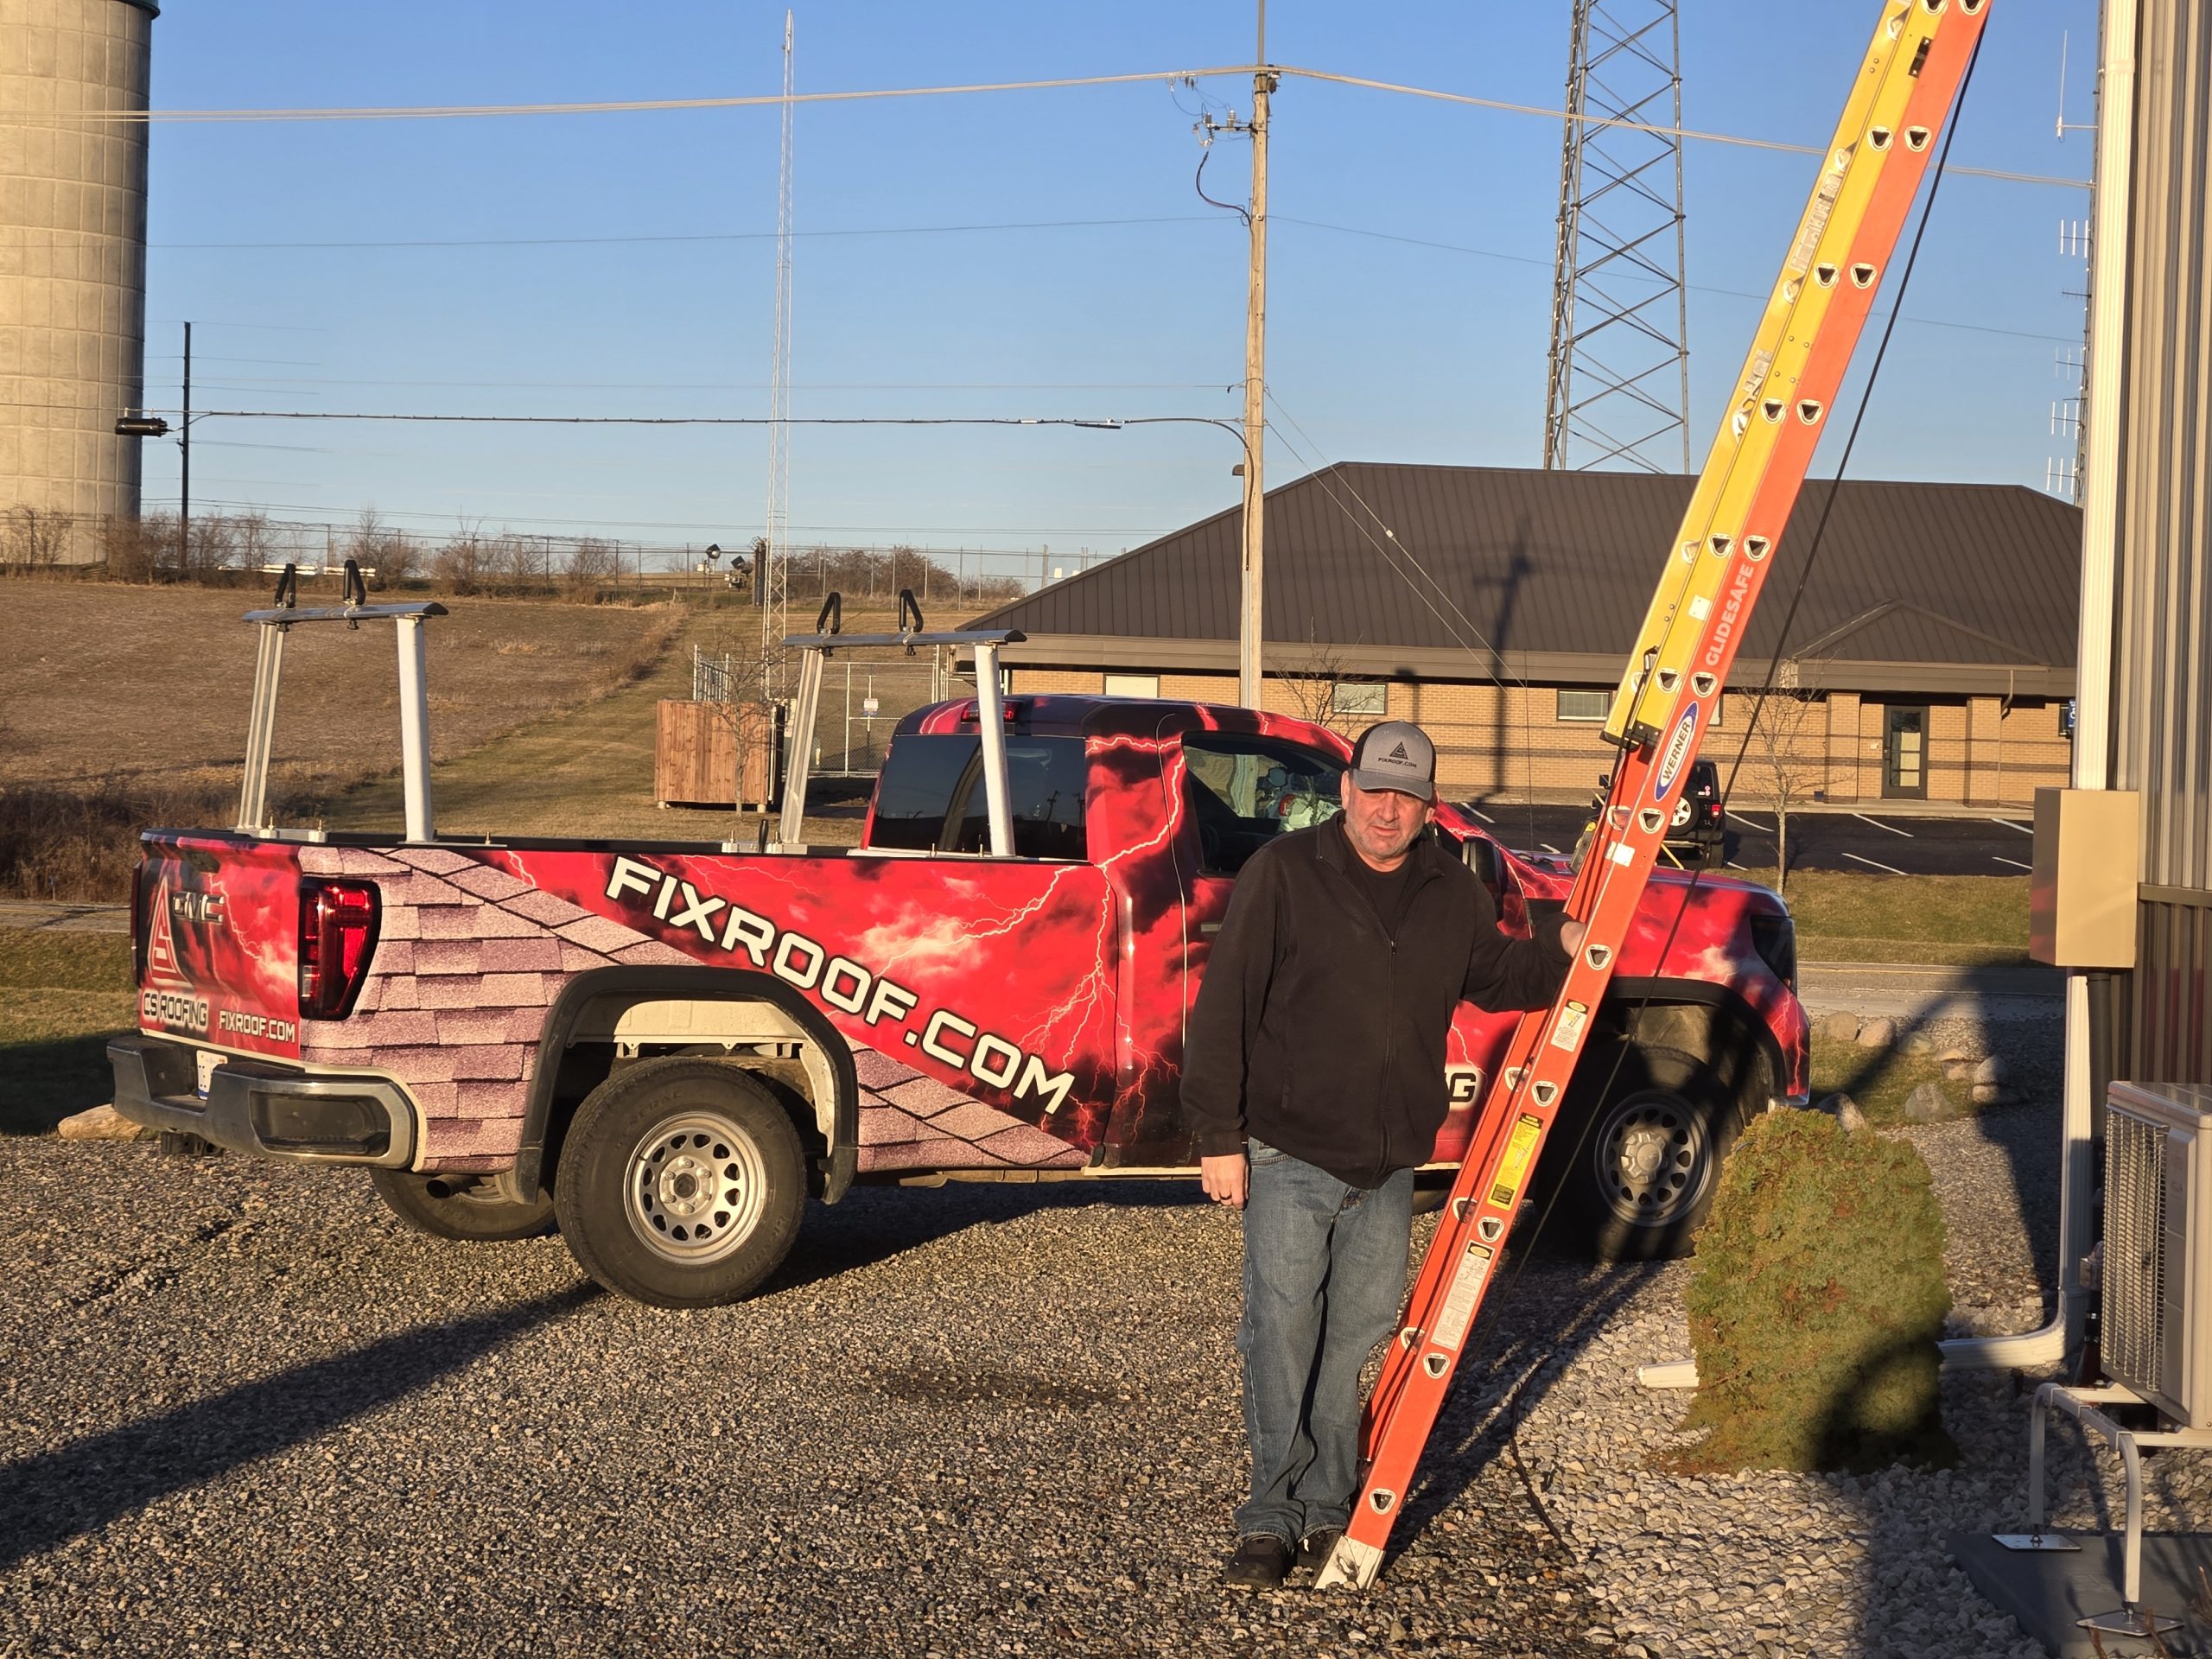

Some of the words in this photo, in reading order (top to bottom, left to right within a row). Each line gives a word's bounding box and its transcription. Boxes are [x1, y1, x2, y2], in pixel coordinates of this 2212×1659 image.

[1706, 562, 1755, 667] GLIDESAFE
[1377, 757, 1417, 768] FIXROOF.COM
[1662, 721, 1692, 782] WERNER
[174, 892, 225, 924] GMC
[605, 855, 1076, 1115] FIXROOF.COM
[143, 993, 157, 1015] CS
[159, 995, 207, 1027] ROOFING
[219, 1010, 296, 1043] FIXROOF.COM
